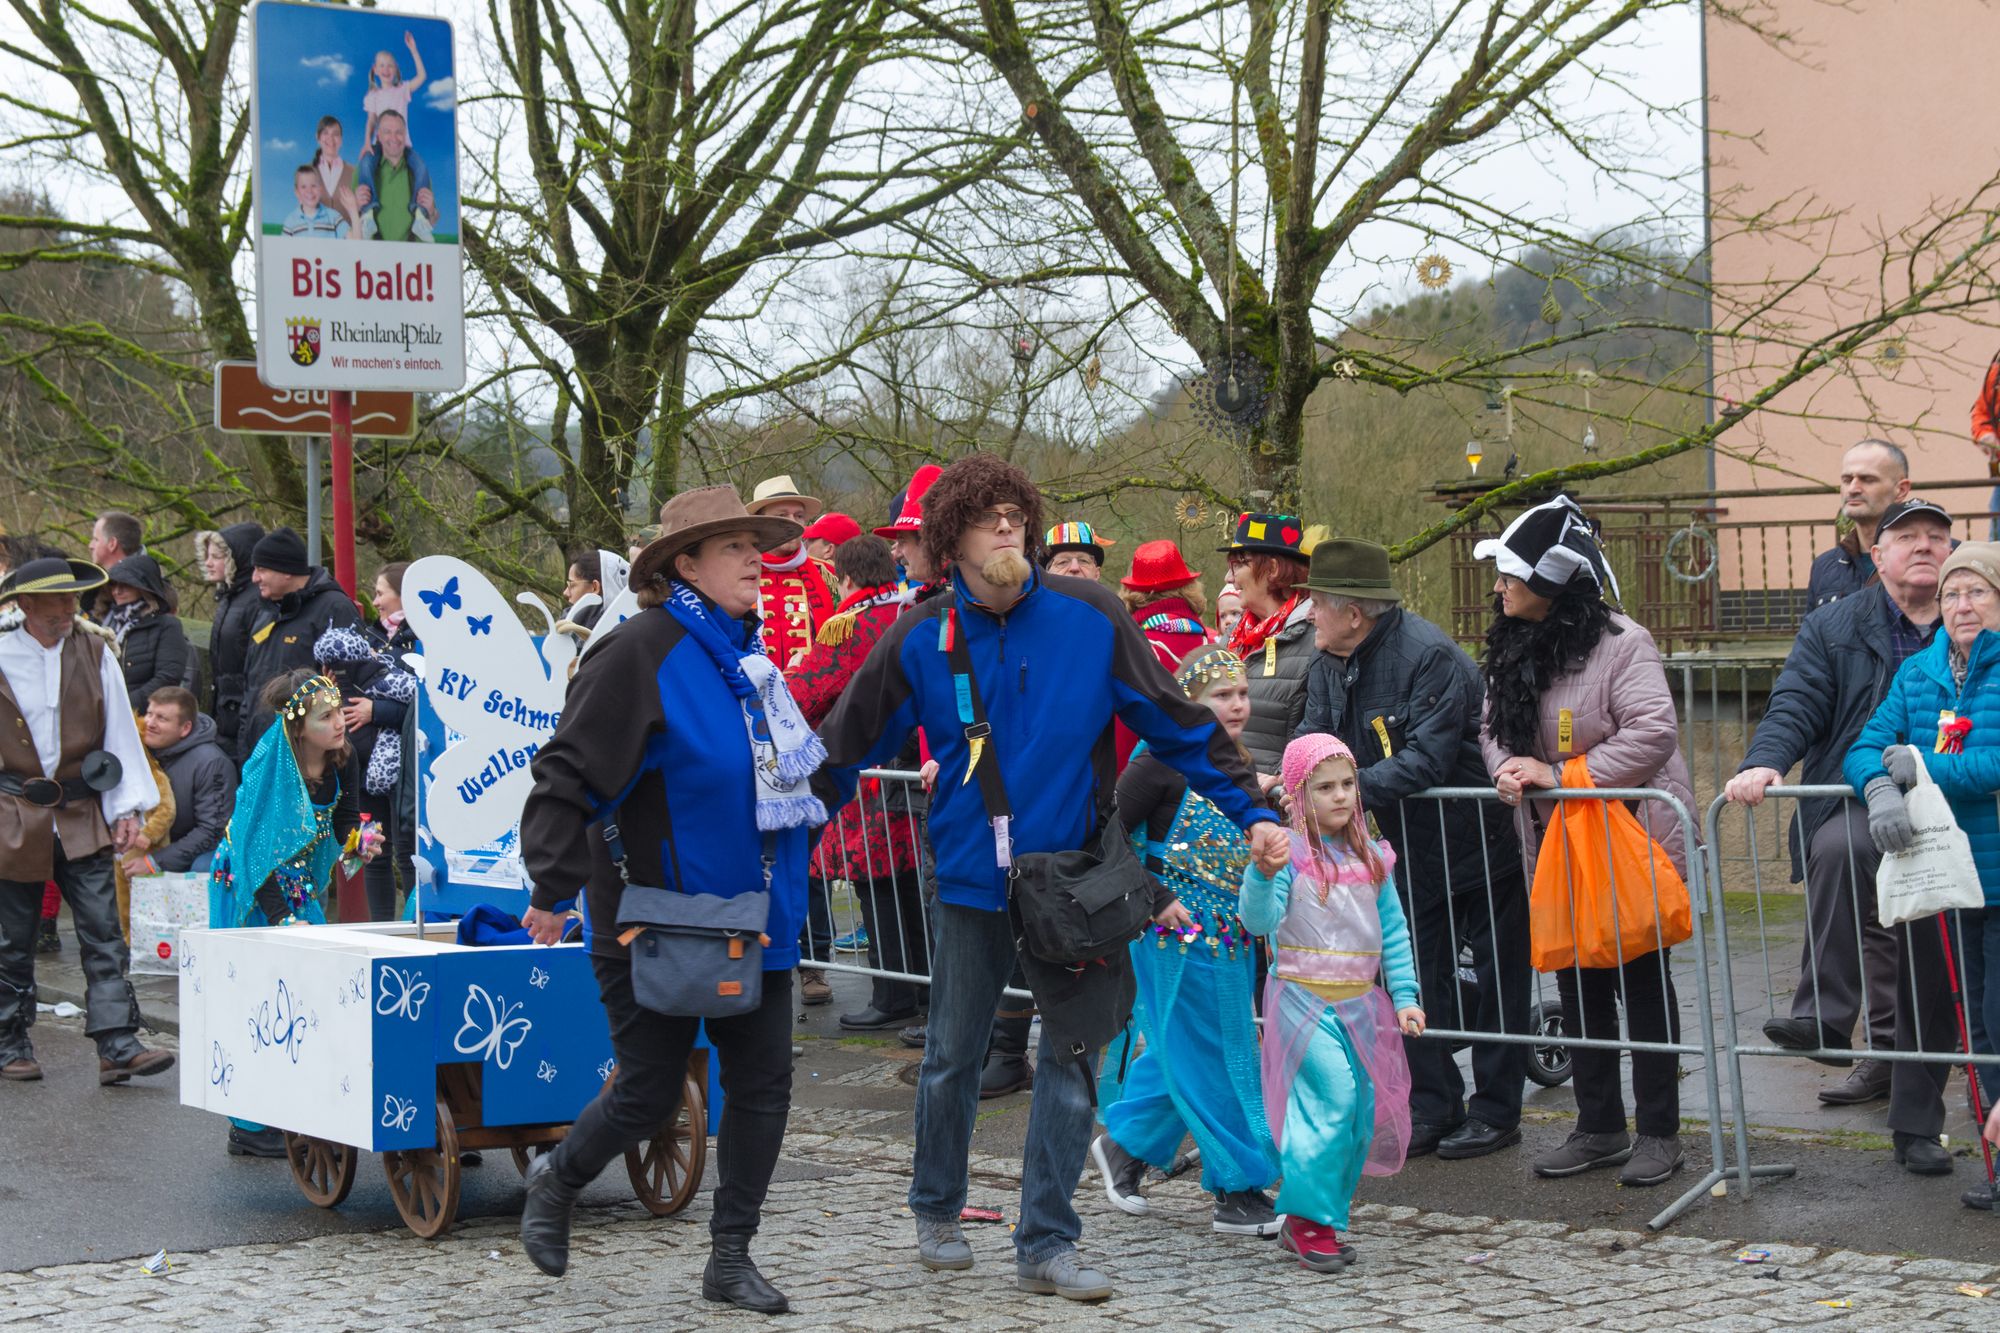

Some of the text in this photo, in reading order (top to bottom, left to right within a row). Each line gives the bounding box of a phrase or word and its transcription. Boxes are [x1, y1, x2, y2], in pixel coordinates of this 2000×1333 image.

[292, 258, 434, 302] Bis bald!
[331, 356, 444, 371] Wir machen's einfach.
[437, 668, 477, 701] KV
